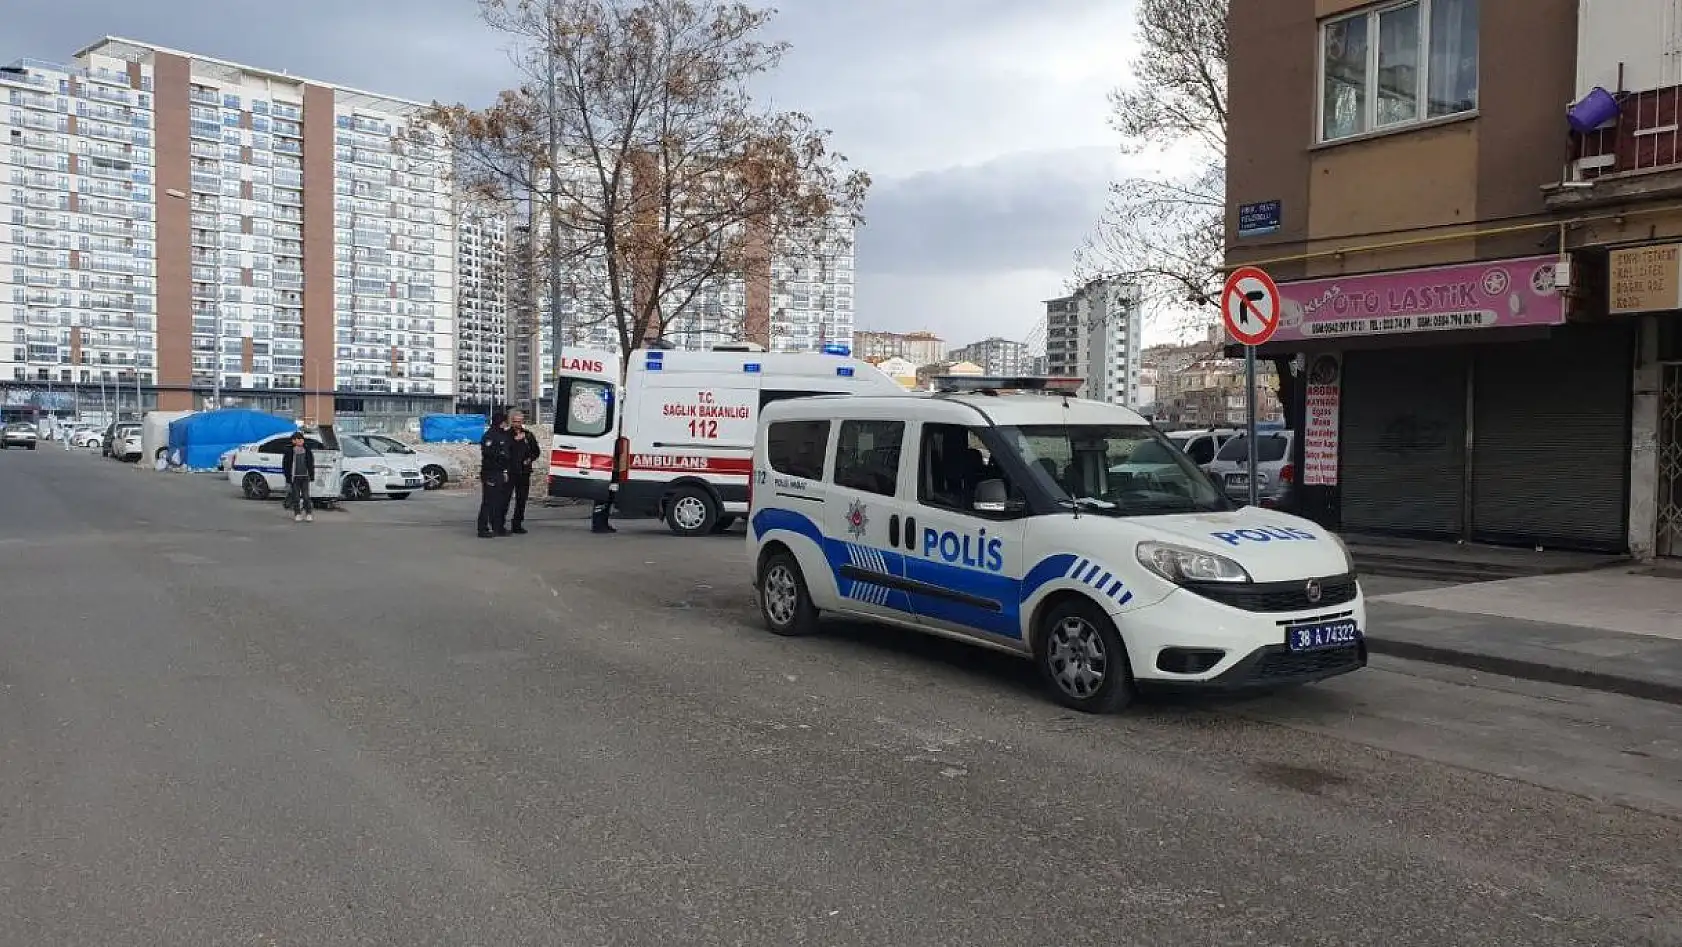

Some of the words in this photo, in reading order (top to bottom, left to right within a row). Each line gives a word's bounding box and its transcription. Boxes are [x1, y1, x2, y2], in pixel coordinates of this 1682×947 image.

[1333, 289, 1379, 314] OTO
[561, 358, 603, 372] LANS
[698, 391, 715, 404] T.C.
[663, 402, 697, 417] SAĞLIK
[699, 404, 750, 419] BAKANLIĞI
[688, 419, 718, 438] 112
[632, 453, 708, 468] AMBULANS
[923, 526, 1003, 572] POLİS
[1298, 629, 1311, 647] 38
[1315, 627, 1322, 645] A
[1325, 623, 1355, 643] 74322
